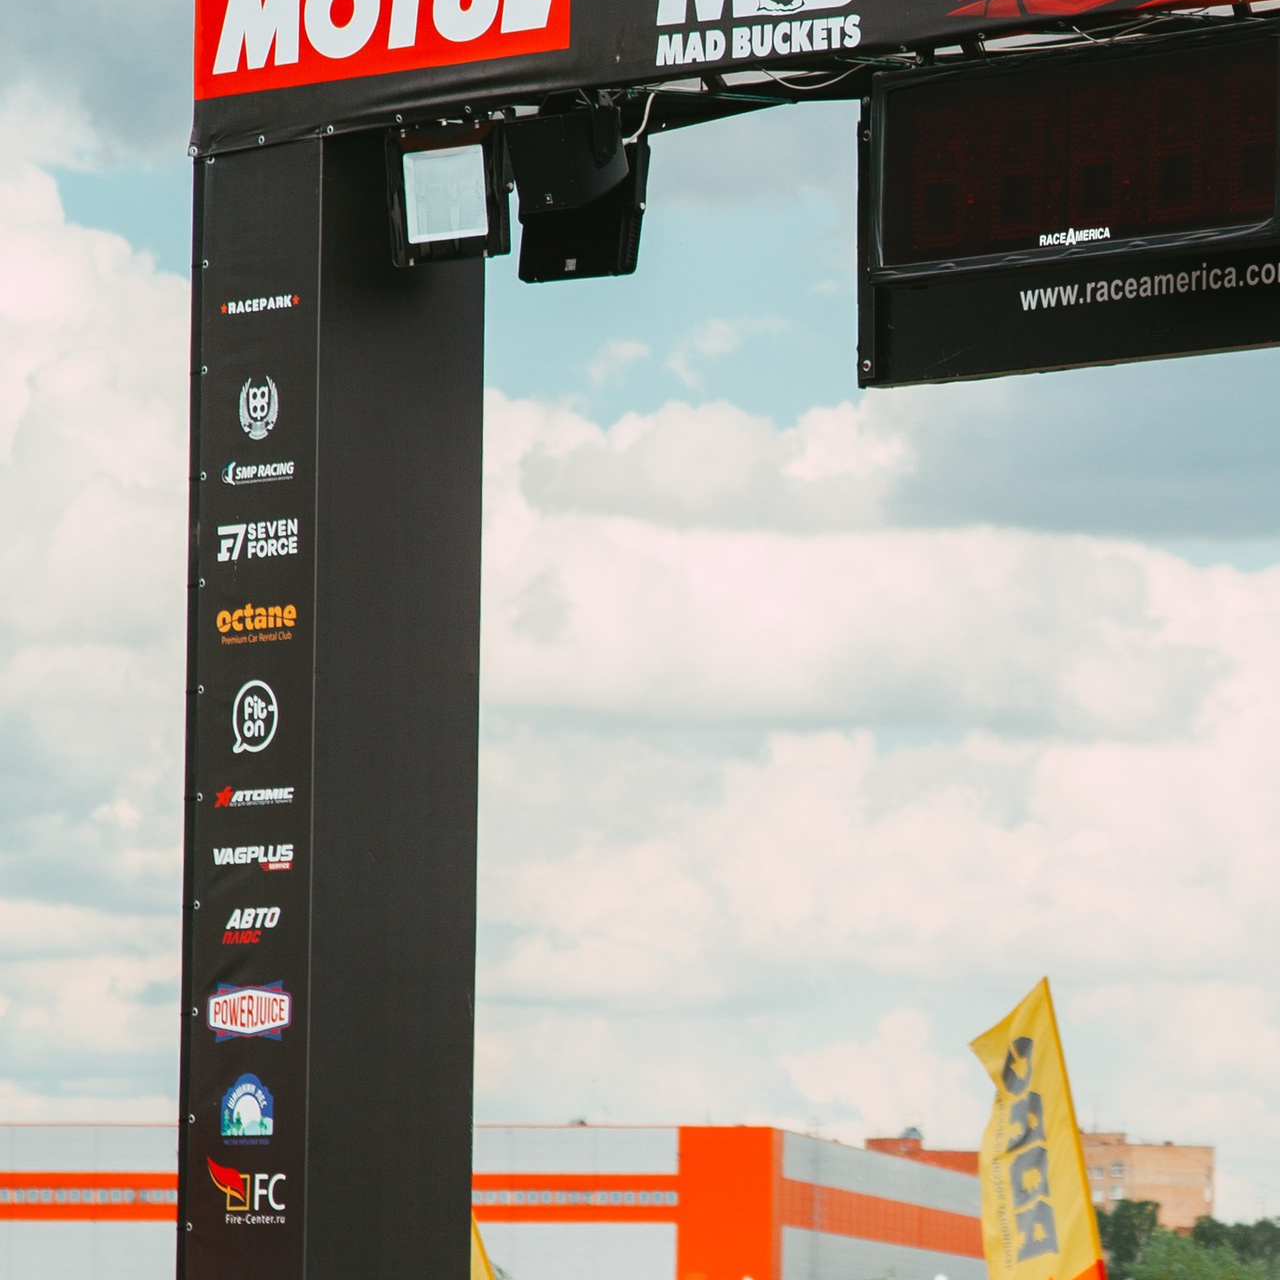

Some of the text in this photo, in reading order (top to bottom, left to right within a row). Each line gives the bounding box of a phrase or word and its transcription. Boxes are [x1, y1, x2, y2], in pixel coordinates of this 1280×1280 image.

[655, 14, 861, 66] MAD BUCKETS
[227, 295, 293, 314] RACEPARK
[235, 461, 295, 480] SMP RACING
[247, 518, 298, 540] SEVEN
[247, 536, 298, 559] FORCE
[216, 602, 297, 633] octane
[243, 720, 265, 738] on
[231, 787, 294, 802] ATOMIC
[213, 844, 294, 866] VAGPLUS
[226, 907, 280, 930] АВТО
[222, 930, 262, 945] ПЛЮС
[213, 995, 285, 1028] POWERJUICE
[254, 1173, 286, 1211] FC
[225, 1213, 286, 1225] Fire-Center.ru
